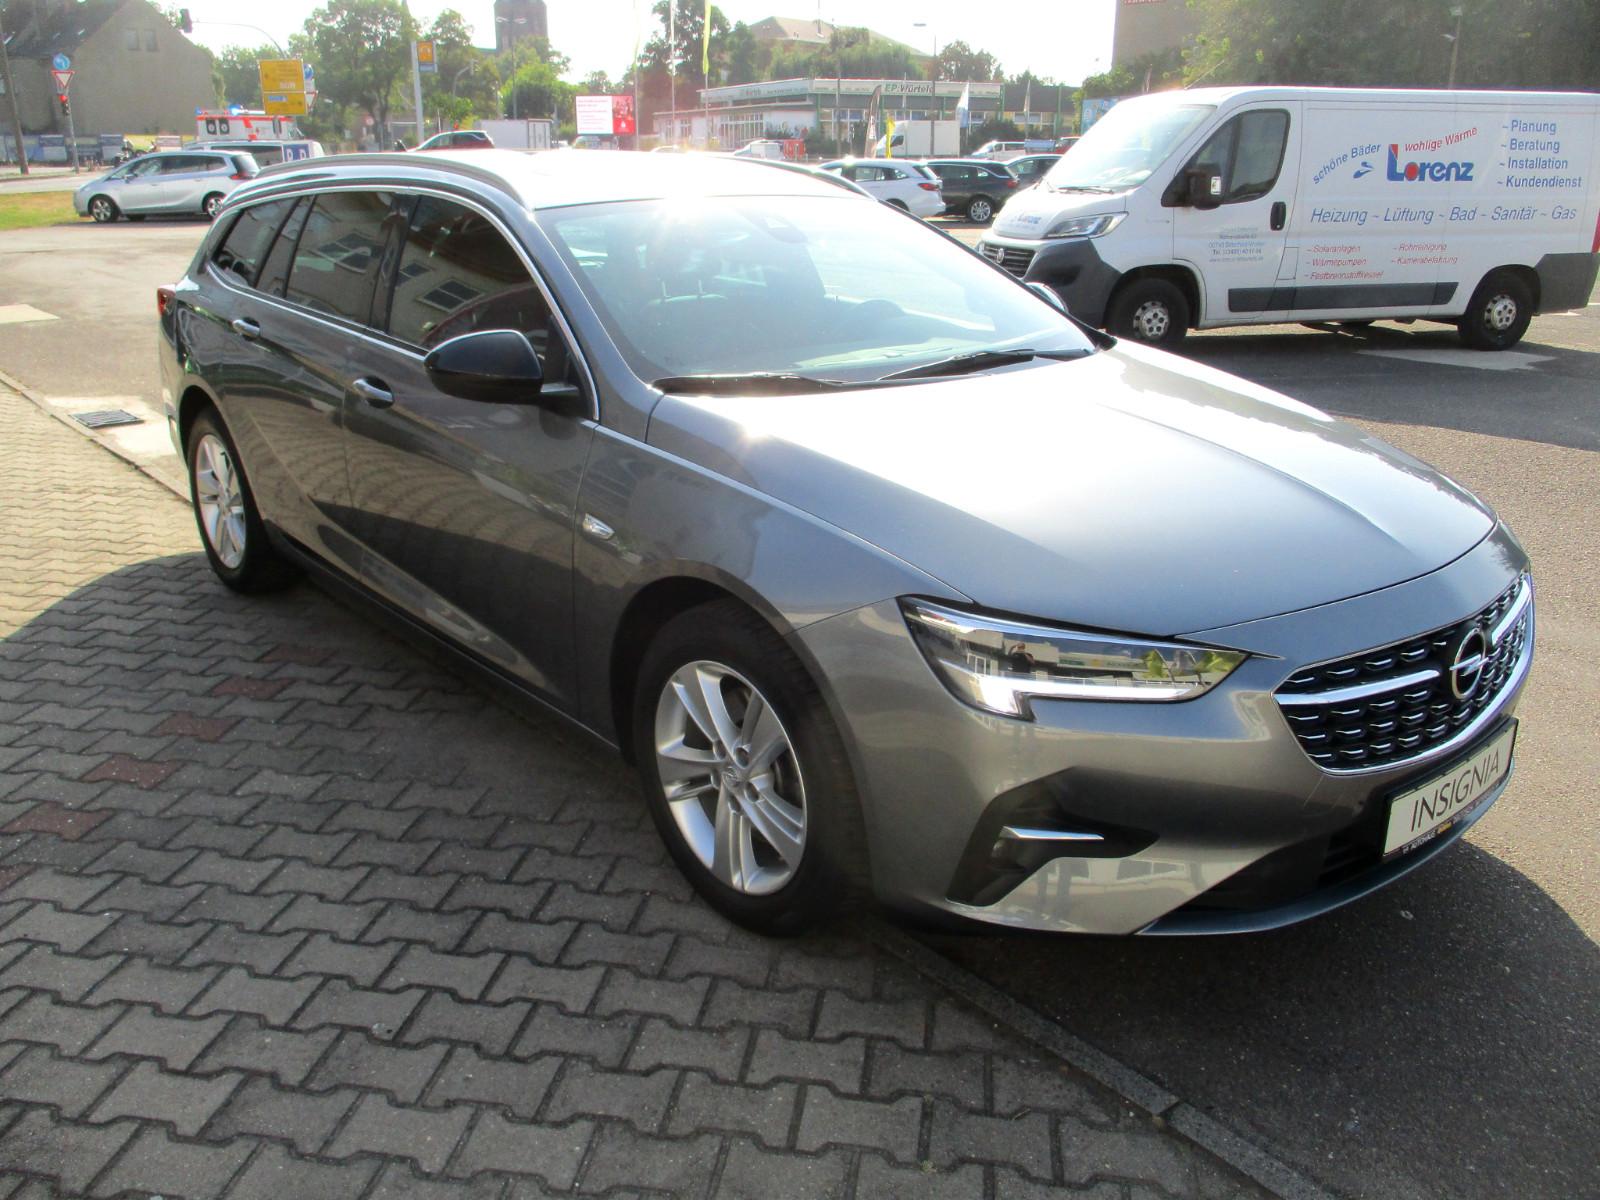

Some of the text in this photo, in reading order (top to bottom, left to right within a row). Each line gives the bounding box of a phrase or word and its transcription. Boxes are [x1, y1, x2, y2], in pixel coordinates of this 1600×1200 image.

[1510, 119, 1558, 135] Planung
[1404, 127, 1478, 152] wohlige Wärme
[1509, 138, 1561, 154] Beratung
[1313, 143, 1382, 184] schöne Bäder
[1386, 143, 1475, 182] Lorenz
[1507, 157, 1569, 170] Installation
[1505, 175, 1583, 188] Kundendienst
[1310, 207, 1368, 226] Heizung
[1383, 207, 1434, 225] Lüftung
[1449, 206, 1478, 221] Bad
[1491, 205, 1538, 221] Sanitär
[1551, 205, 1577, 220] Gas
[1411, 748, 1500, 833] INSIGNIA
